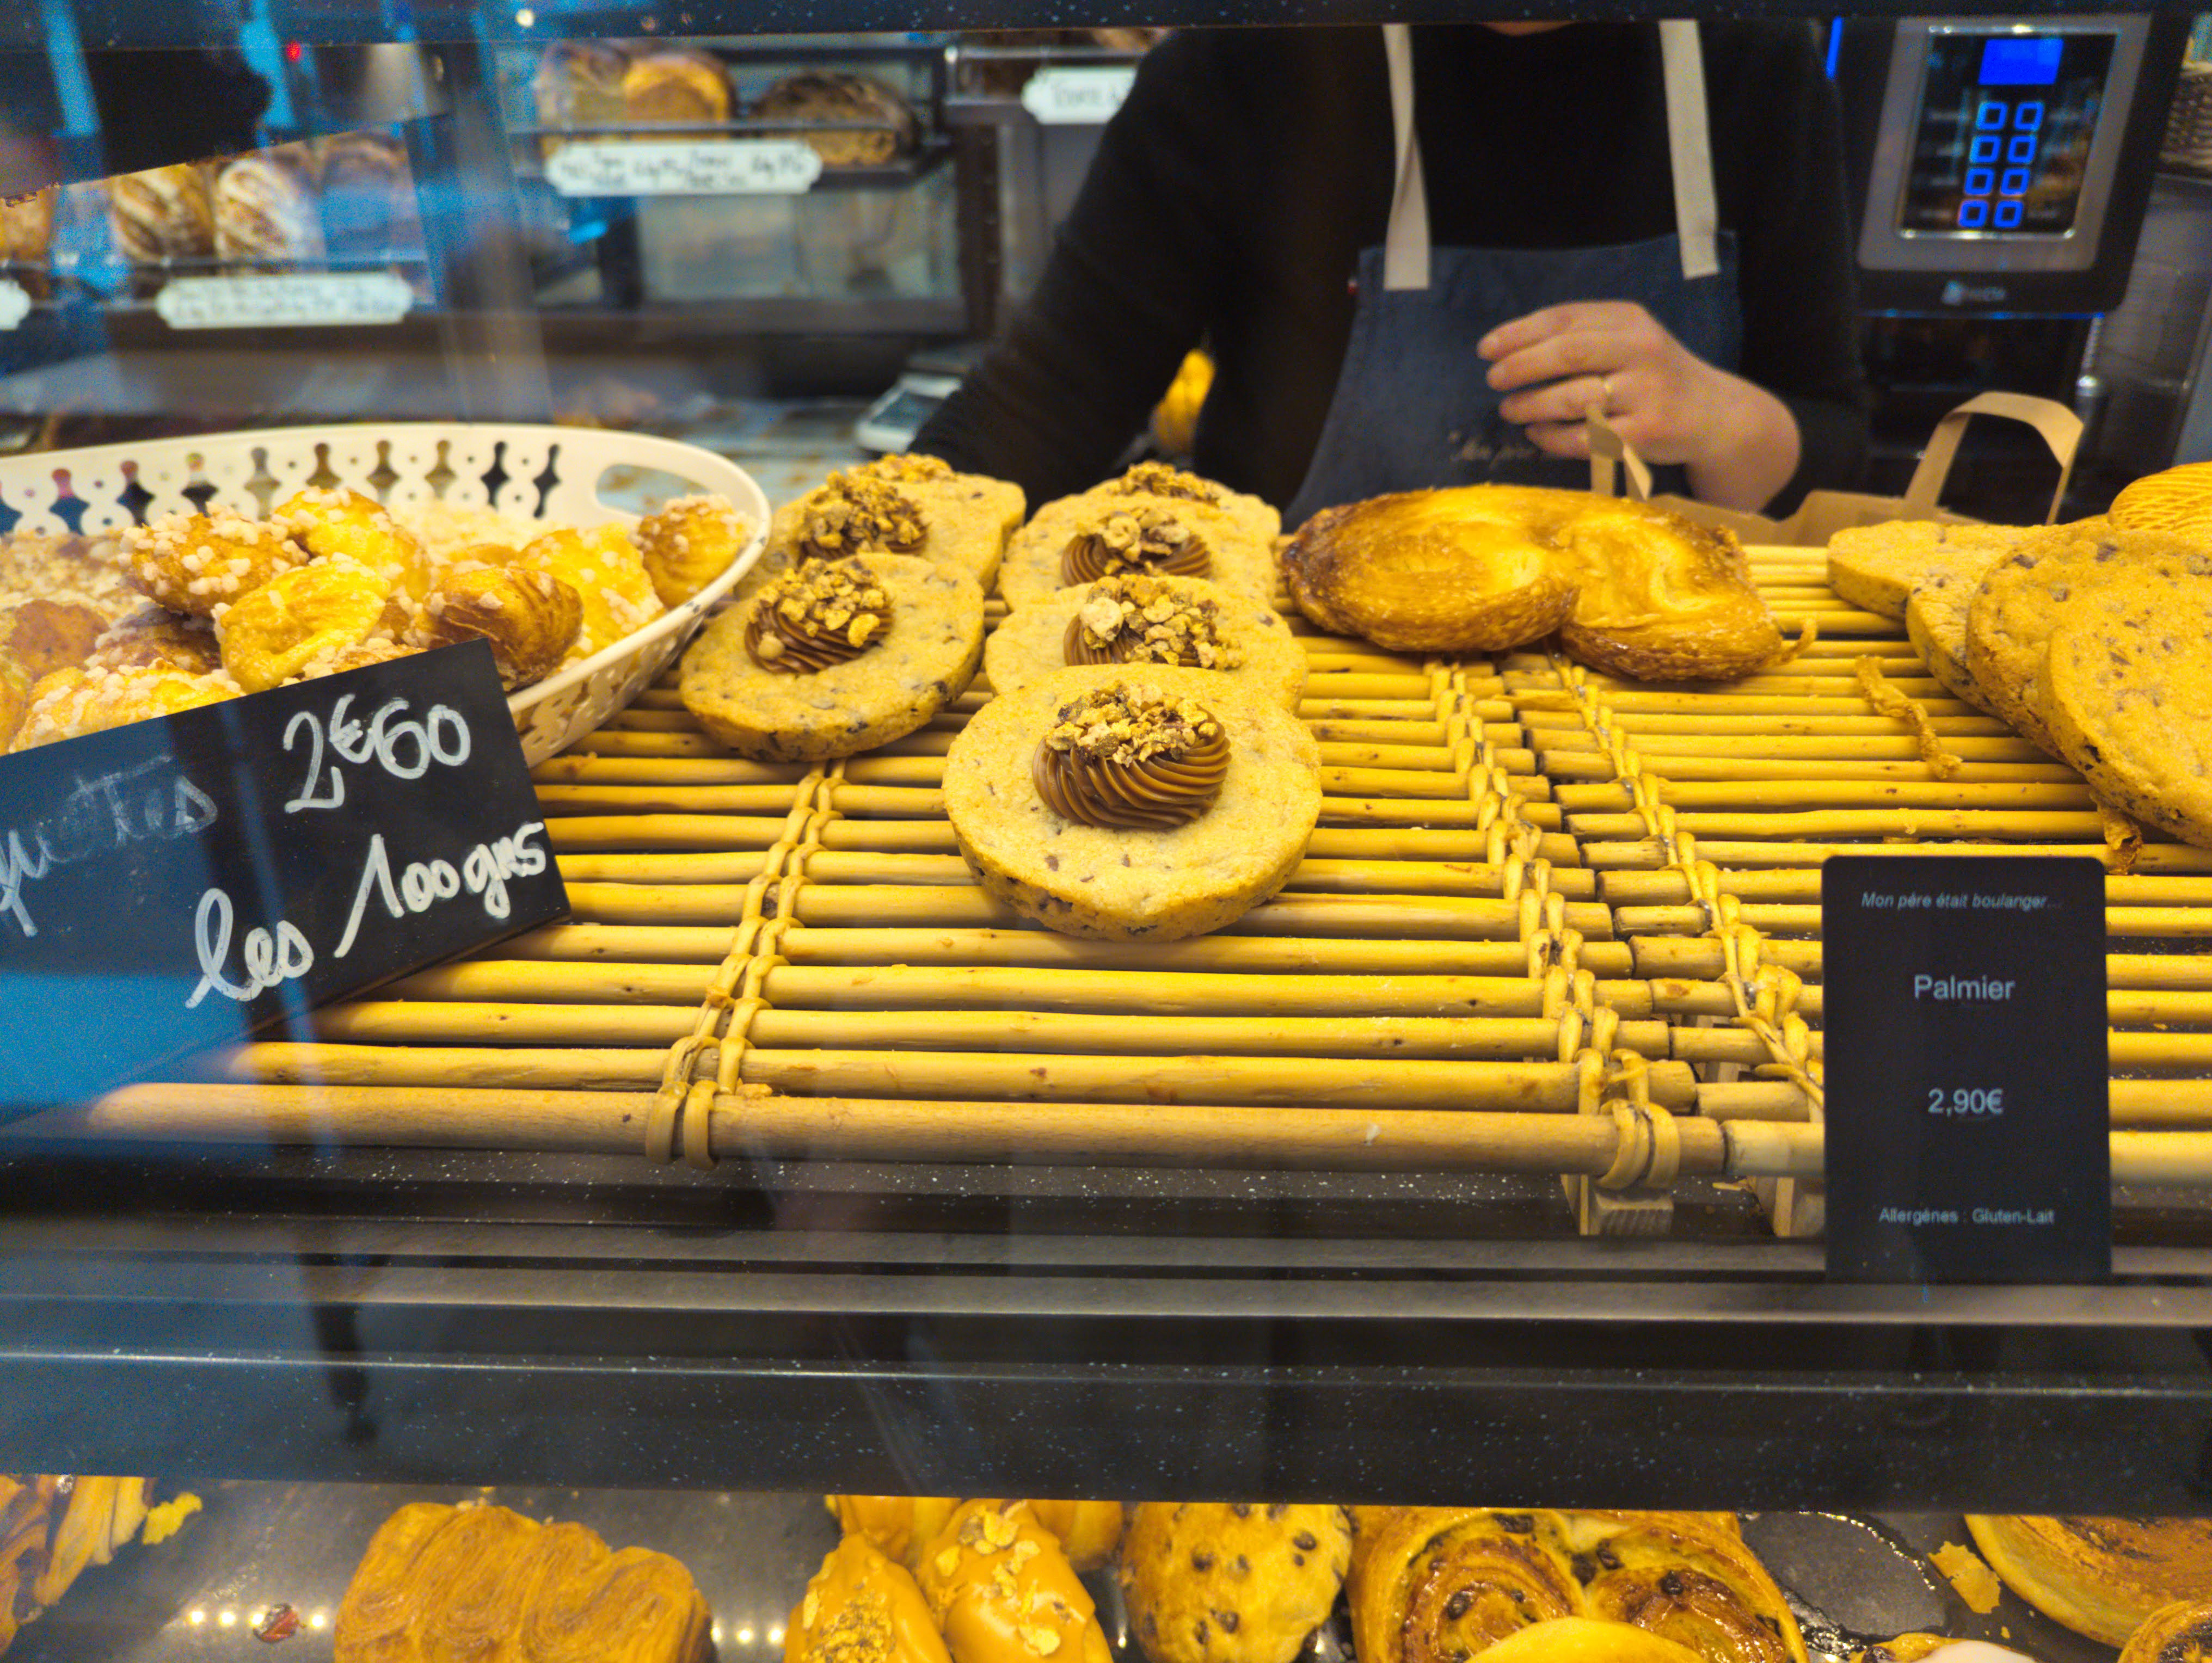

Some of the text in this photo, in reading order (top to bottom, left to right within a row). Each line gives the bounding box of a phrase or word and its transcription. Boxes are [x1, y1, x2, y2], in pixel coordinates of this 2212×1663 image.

[1861, 892, 1894, 908] Mon
[1936, 892, 1968, 908] était
[185, 888, 314, 1008] les
[1914, 974, 2016, 1000] Palmier
[1927, 1088, 2004, 1117] 2,90€
[1973, 1208, 2055, 1224] Gluten-Lait
